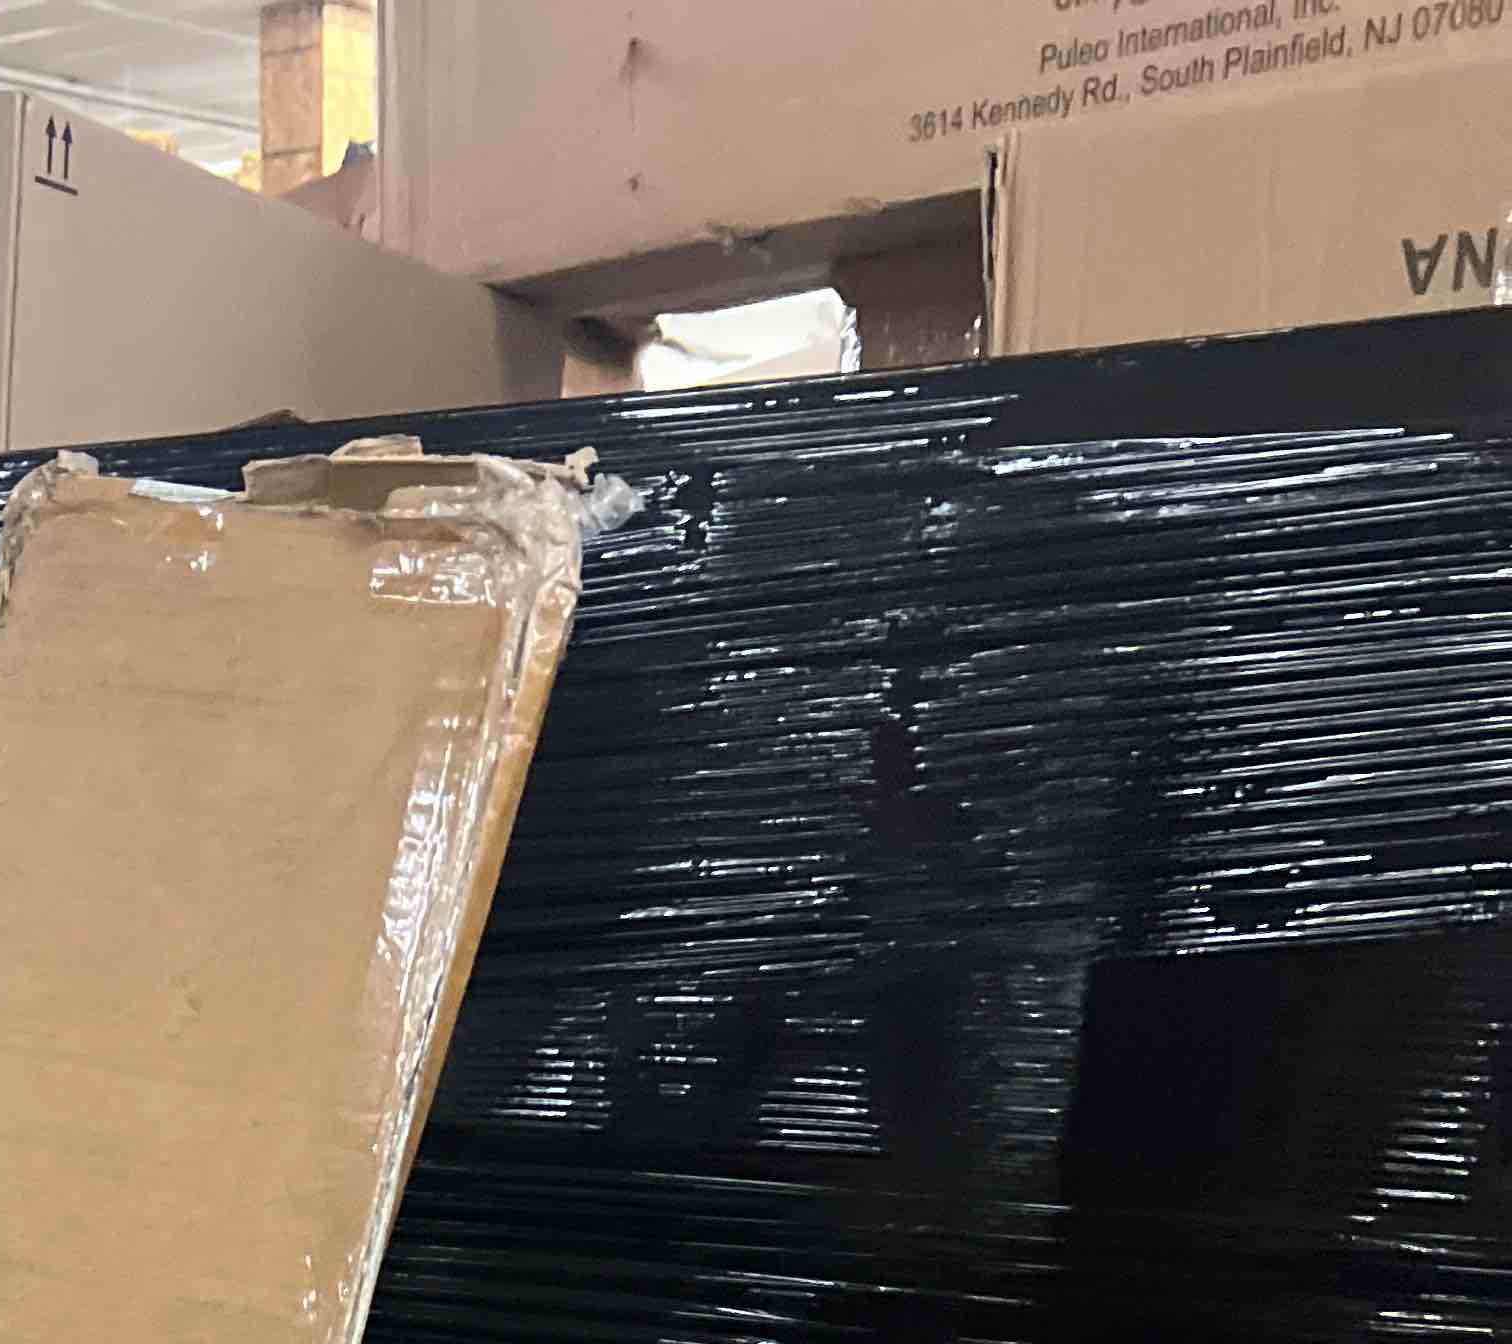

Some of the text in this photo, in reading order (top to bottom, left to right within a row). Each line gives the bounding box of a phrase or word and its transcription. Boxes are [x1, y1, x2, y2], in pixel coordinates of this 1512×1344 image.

[907, 106, 964, 143] 3614
[971, 84, 1075, 130] Kennedy
[1140, 54, 1215, 96] South
[1222, 24, 1353, 80] Plainfield,
[1364, 12, 1403, 50] NJ
[1040, 37, 1109, 74] Puleo
[1117, 0, 1282, 58] International,
